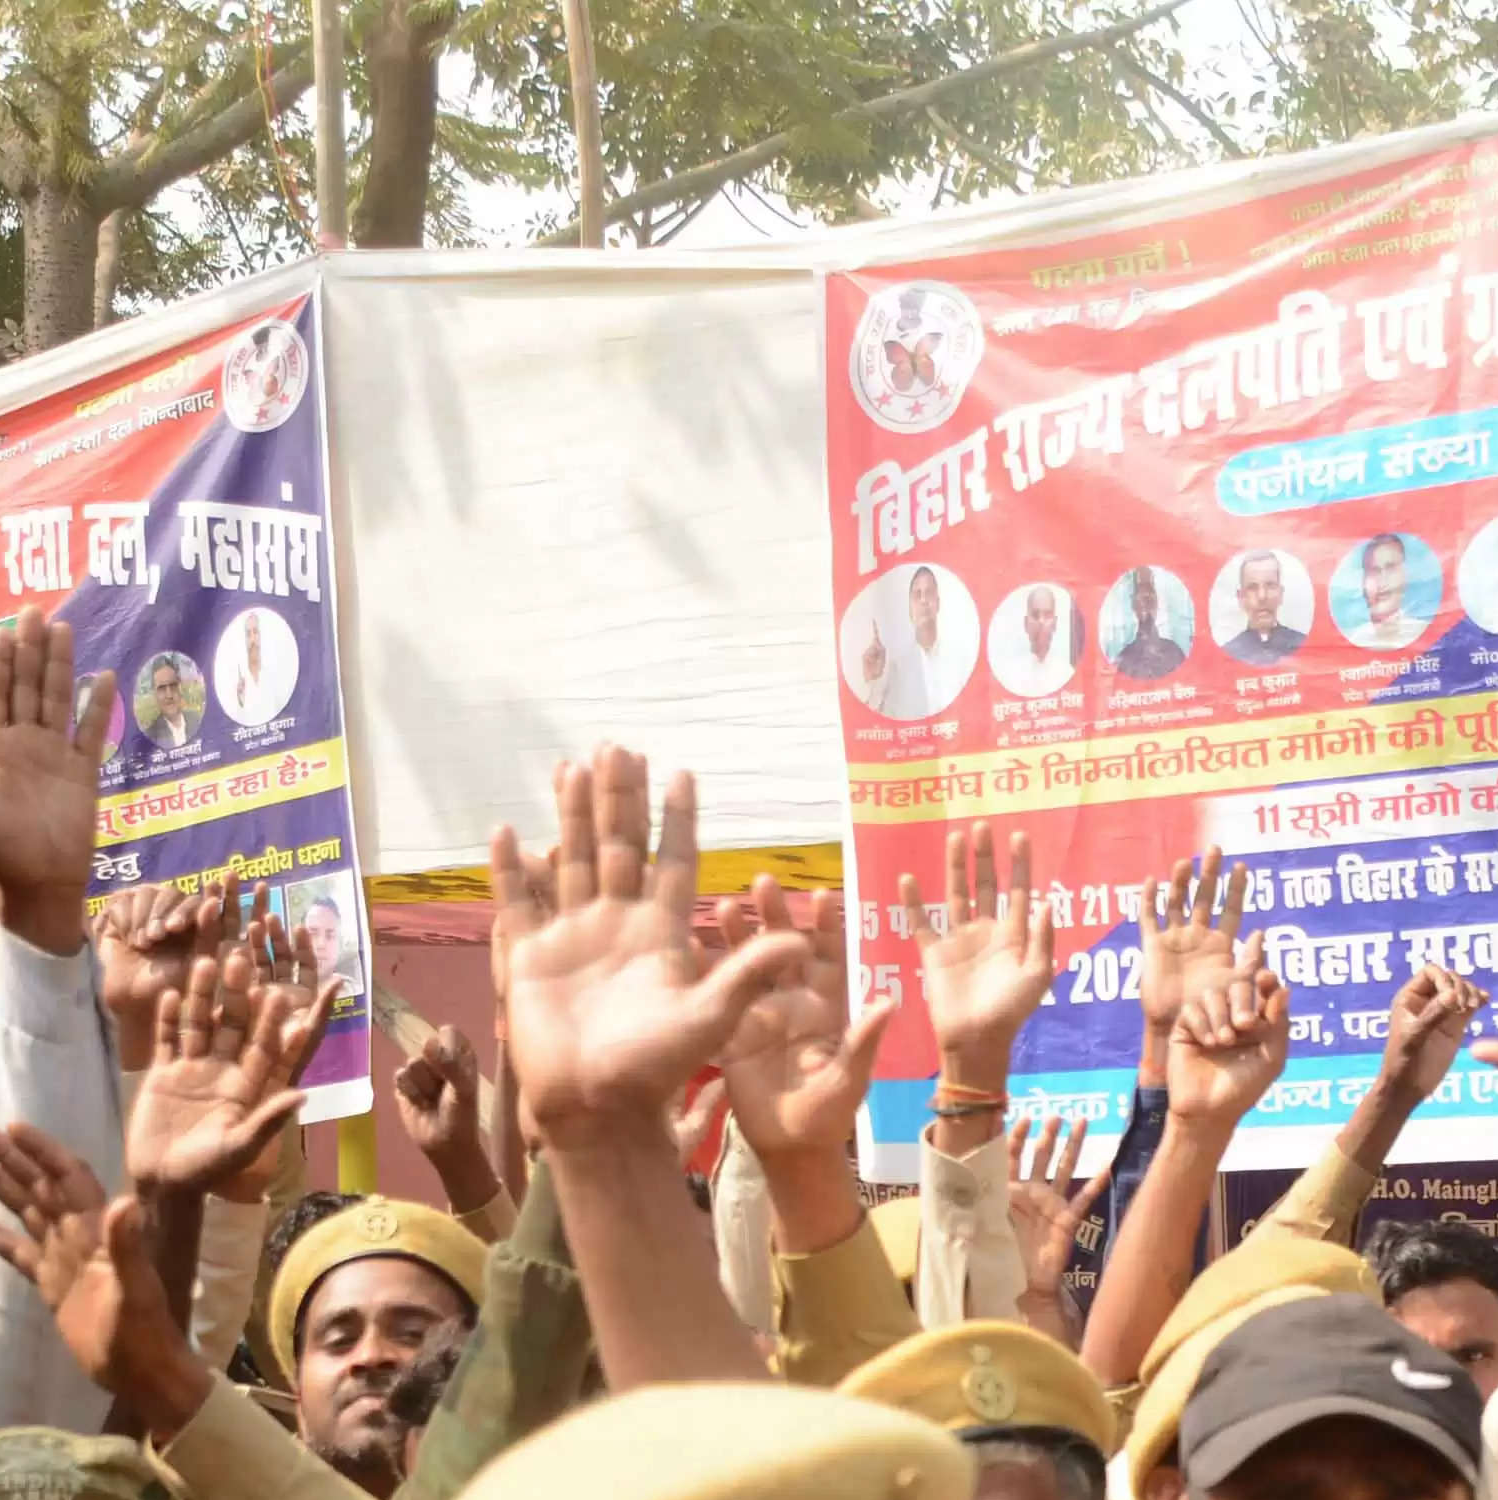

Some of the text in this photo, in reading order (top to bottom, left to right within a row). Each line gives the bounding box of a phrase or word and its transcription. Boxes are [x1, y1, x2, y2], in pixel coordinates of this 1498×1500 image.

[138, 388, 216, 429] जिन्दाबाद
[852, 461, 992, 576] बिहार
[995, 374, 1132, 491] राज्य
[1139, 290, 1348, 439] दलपति
[1357, 252, 1460, 382] एवं
[1231, 442, 1368, 500] पंजीयन
[1380, 427, 1490, 478] संख्या
[0, 502, 74, 596] रक्षा
[81, 501, 161, 604] दल,
[178, 481, 322, 603] महासंघ
[849, 763, 983, 808] महासंघ
[994, 758, 1030, 796] के
[1044, 736, 1269, 790] निम्नलिखित
[1280, 718, 1377, 762] मांगो
[1386, 708, 1444, 750] की
[121, 772, 220, 827] संघर्षरत
[227, 767, 270, 798] रहा
[1255, 804, 1279, 834] 11
[1289, 796, 1360, 838] सूत्री
[1371, 782, 1462, 823] मांगो
[175, 874, 200, 896] पर
[297, 837, 342, 866] धरना
[1047, 881, 1074, 929] से
[1081, 885, 1110, 926] 21
[1208, 867, 1273, 916] 225
[1279, 866, 1333, 909] तक
[1335, 852, 1419, 904] बिहार
[1421, 845, 1456, 896] के
[1068, 948, 1143, 1006] 202
[1264, 924, 1393, 987] बिहार
[1372, 1179, 1417, 1201] H.O.
